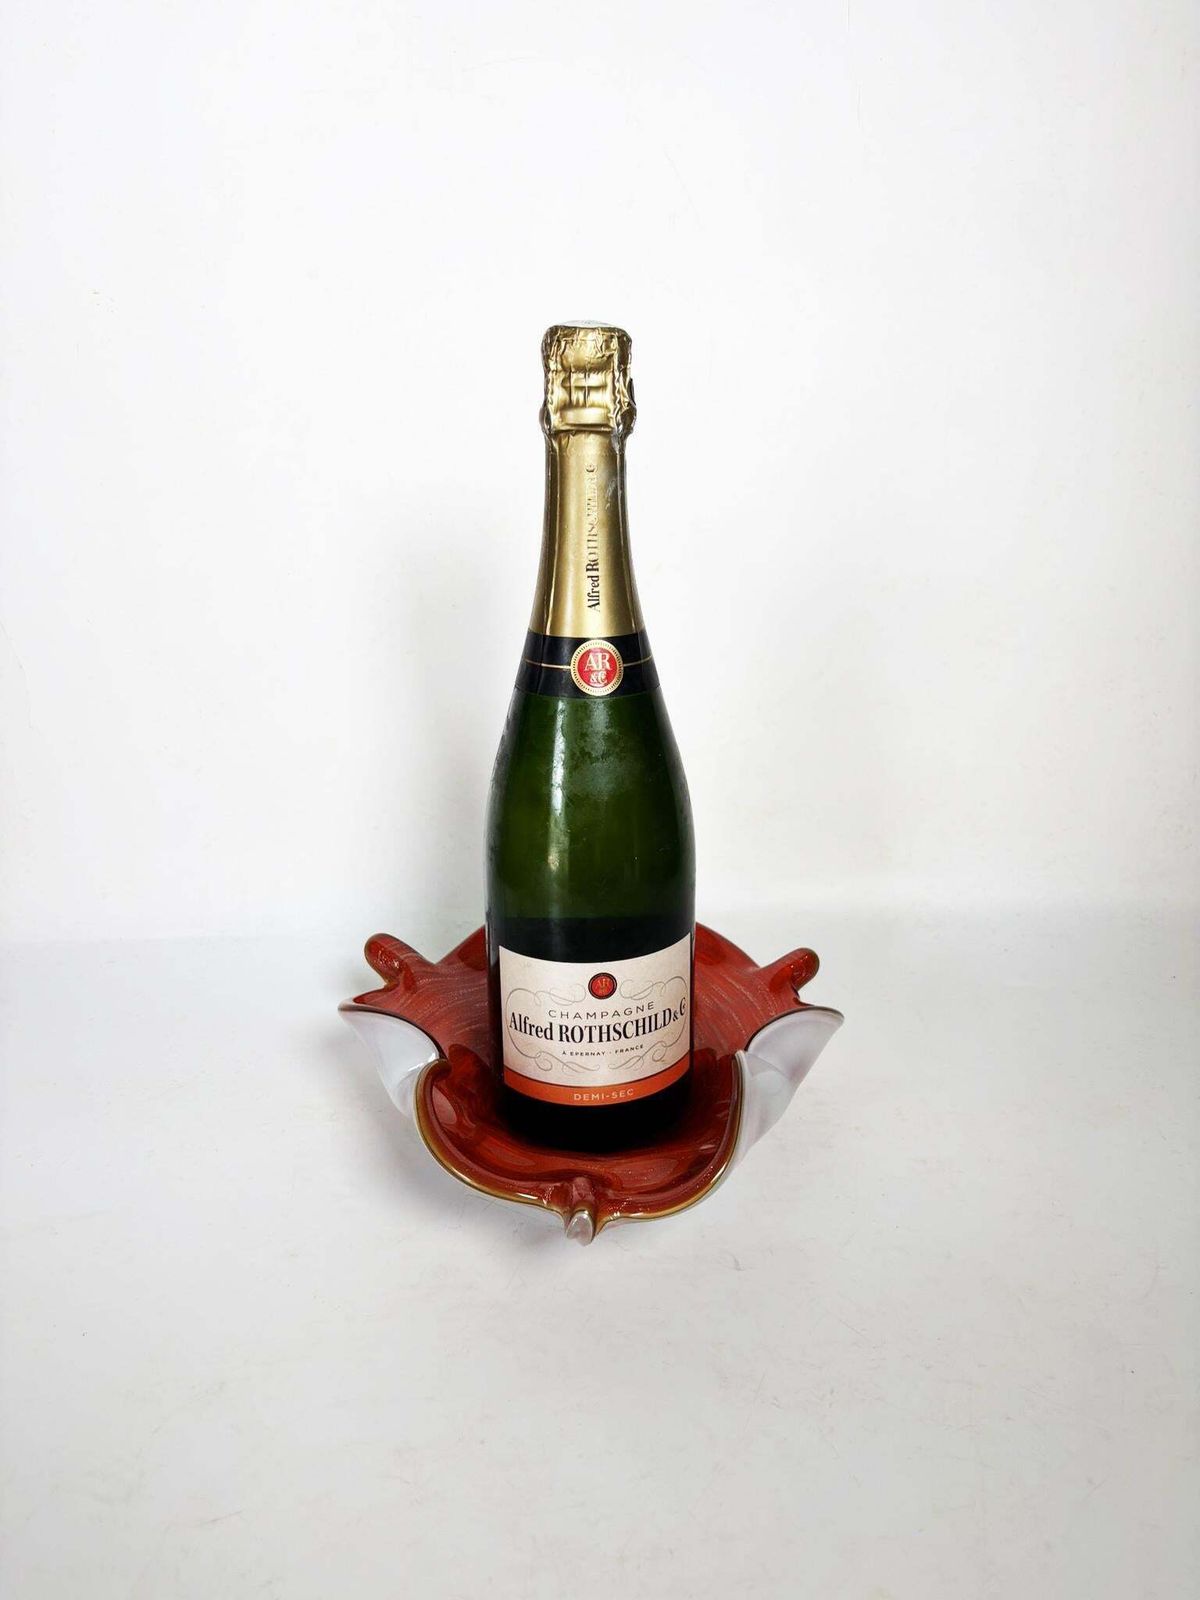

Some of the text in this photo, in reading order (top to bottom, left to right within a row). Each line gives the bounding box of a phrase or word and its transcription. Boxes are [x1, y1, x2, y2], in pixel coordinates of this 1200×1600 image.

[586, 575, 601, 613] Alfred
[584, 652, 613, 671] AR
[548, 1001, 655, 1021] CHAMPAGNE
[509, 1011, 554, 1042] Alfred
[614, 1043, 644, 1055] FRANCE
[573, 1088, 634, 1101] DEMI-SEC
